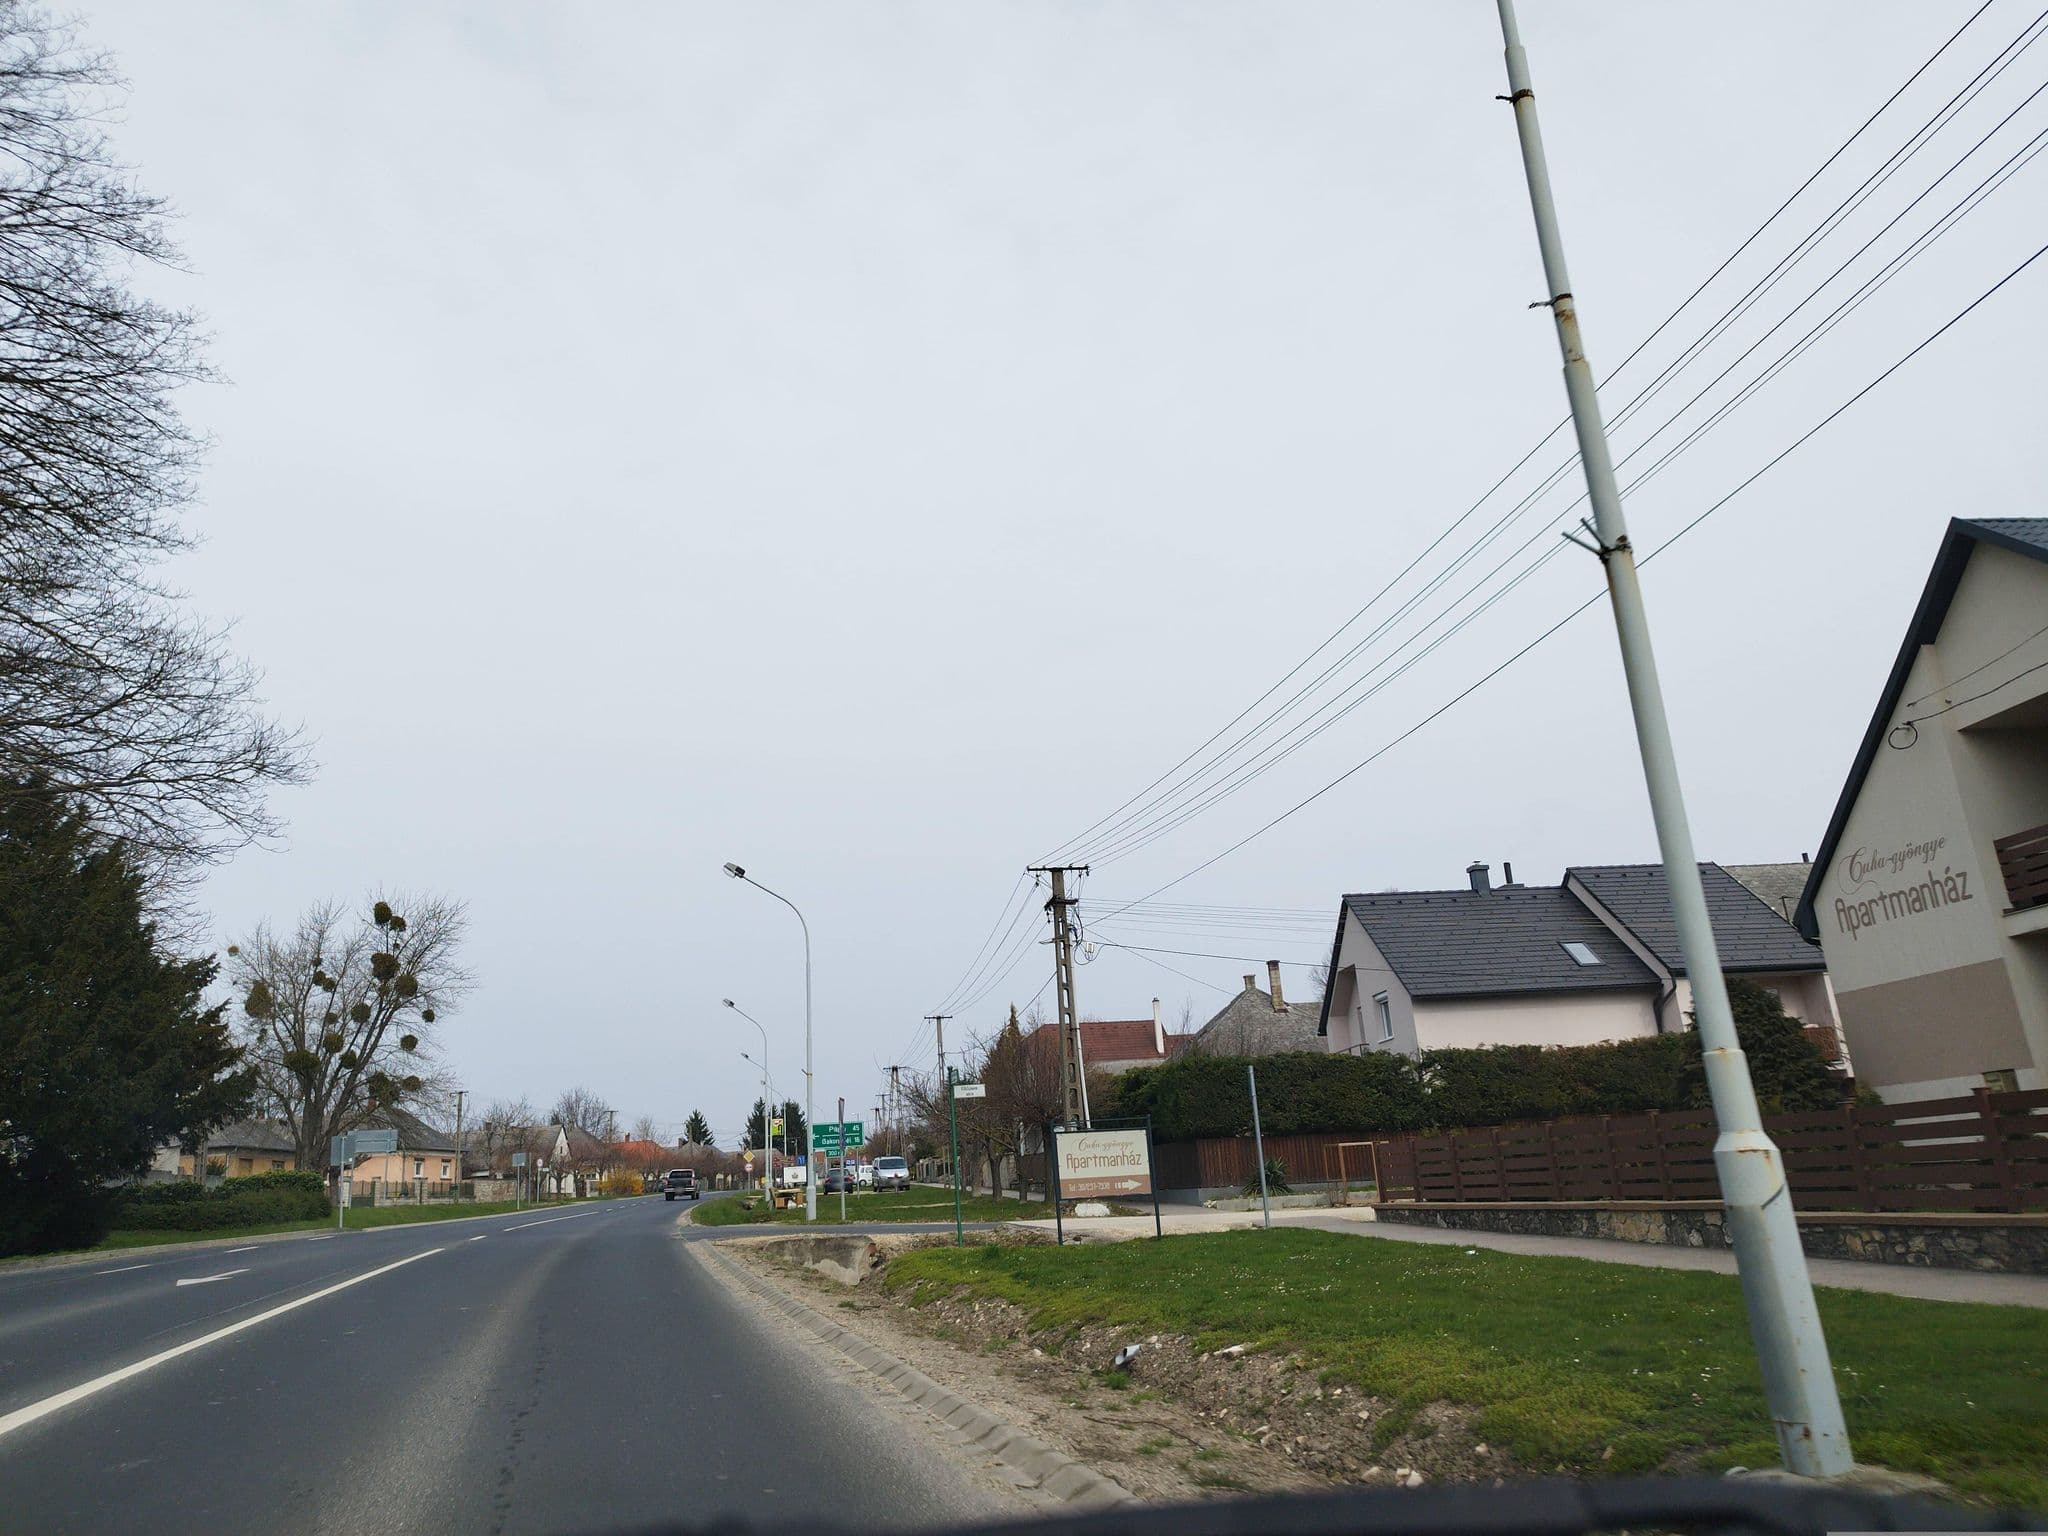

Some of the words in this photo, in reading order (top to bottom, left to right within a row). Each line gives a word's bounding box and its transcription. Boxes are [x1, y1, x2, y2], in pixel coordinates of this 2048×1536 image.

[1838, 837, 1945, 891] Cuha-gyöngye
[1834, 866, 1973, 941] Apartmanház
[1066, 1150, 1142, 1173] Apartmanház
